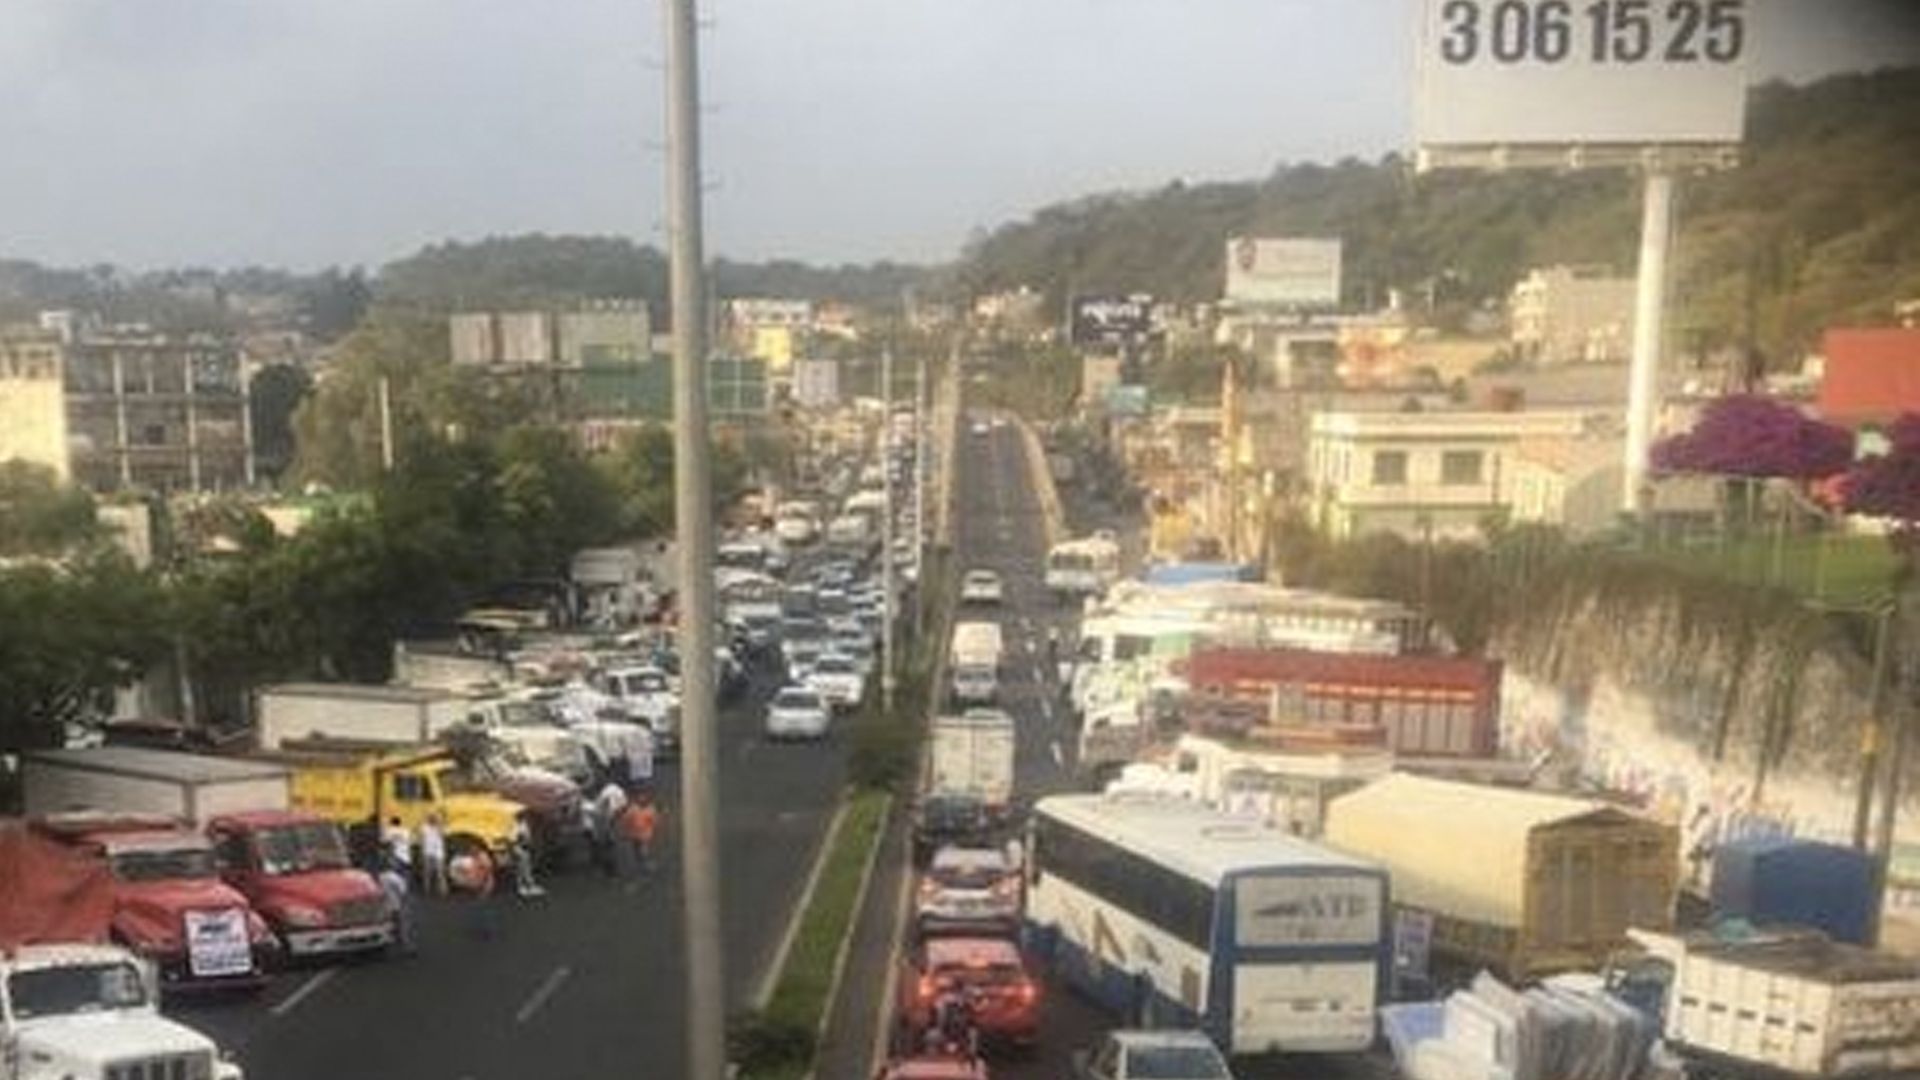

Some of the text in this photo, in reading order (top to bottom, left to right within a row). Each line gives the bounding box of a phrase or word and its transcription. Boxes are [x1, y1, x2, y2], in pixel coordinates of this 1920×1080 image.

[1441, 0, 1744, 63] 3 06 15 25
